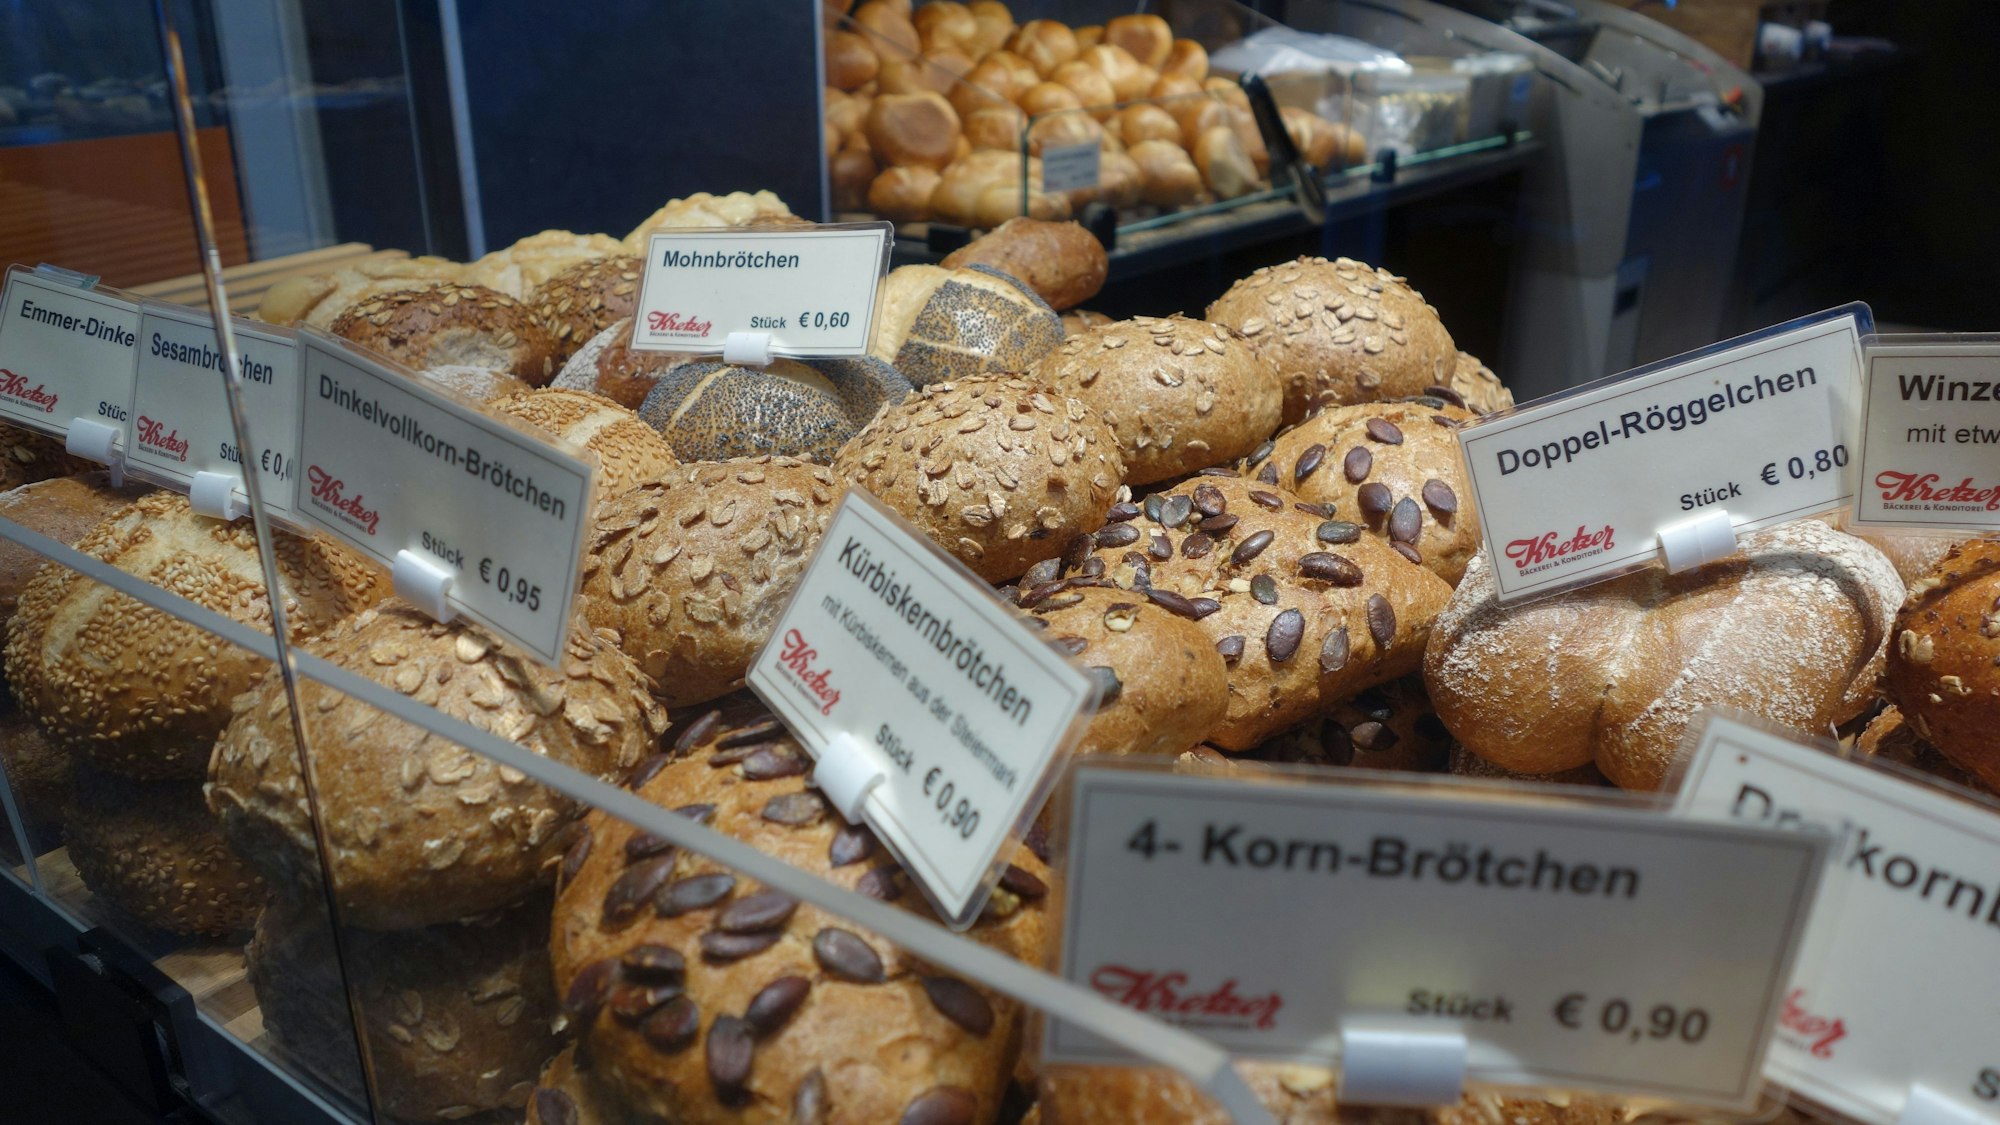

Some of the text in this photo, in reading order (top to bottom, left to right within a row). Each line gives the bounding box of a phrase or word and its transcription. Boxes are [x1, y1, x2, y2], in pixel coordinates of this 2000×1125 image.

[663, 251, 799, 268] Mohnbrötchen
[20, 299, 135, 347] Emmer-Dinke
[647, 311, 712, 338] Kretzer
[751, 312, 849, 330] Stück € 0,60
[152, 332, 273, 385] Sesambrhen
[98, 401, 127, 422] Stüc
[1497, 366, 1816, 475] Doppel-Röggelchen
[1907, 424, 1946, 443] mit
[137, 415, 189, 463] Kretzer
[220, 442, 244, 465] Stüc
[261, 449, 271, 472] €
[319, 374, 565, 520] Dinkelvollkorn-Brötchen
[307, 465, 379, 535] Kretzer
[1680, 444, 1849, 511] Stück € 0,80
[1875, 471, 2000, 511] Kretzer
[422, 531, 541, 612] Stück € 0,95
[1505, 525, 1615, 569] Kretzer
[1520, 564, 1552, 577] BÄCKEREI
[1561, 548, 1603, 565] KONDITOREI
[838, 536, 1033, 726] Kürbiskernbrötchen
[780, 629, 839, 716] Kretzer
[821, 595, 1018, 791] mit Kürbiskernen aus der Steiermark
[876, 722, 980, 841] Stück € 0,90
[1126, 819, 1641, 899] 4- Korn-Brötchen
[1406, 988, 1711, 1045] Stück € 0,90
